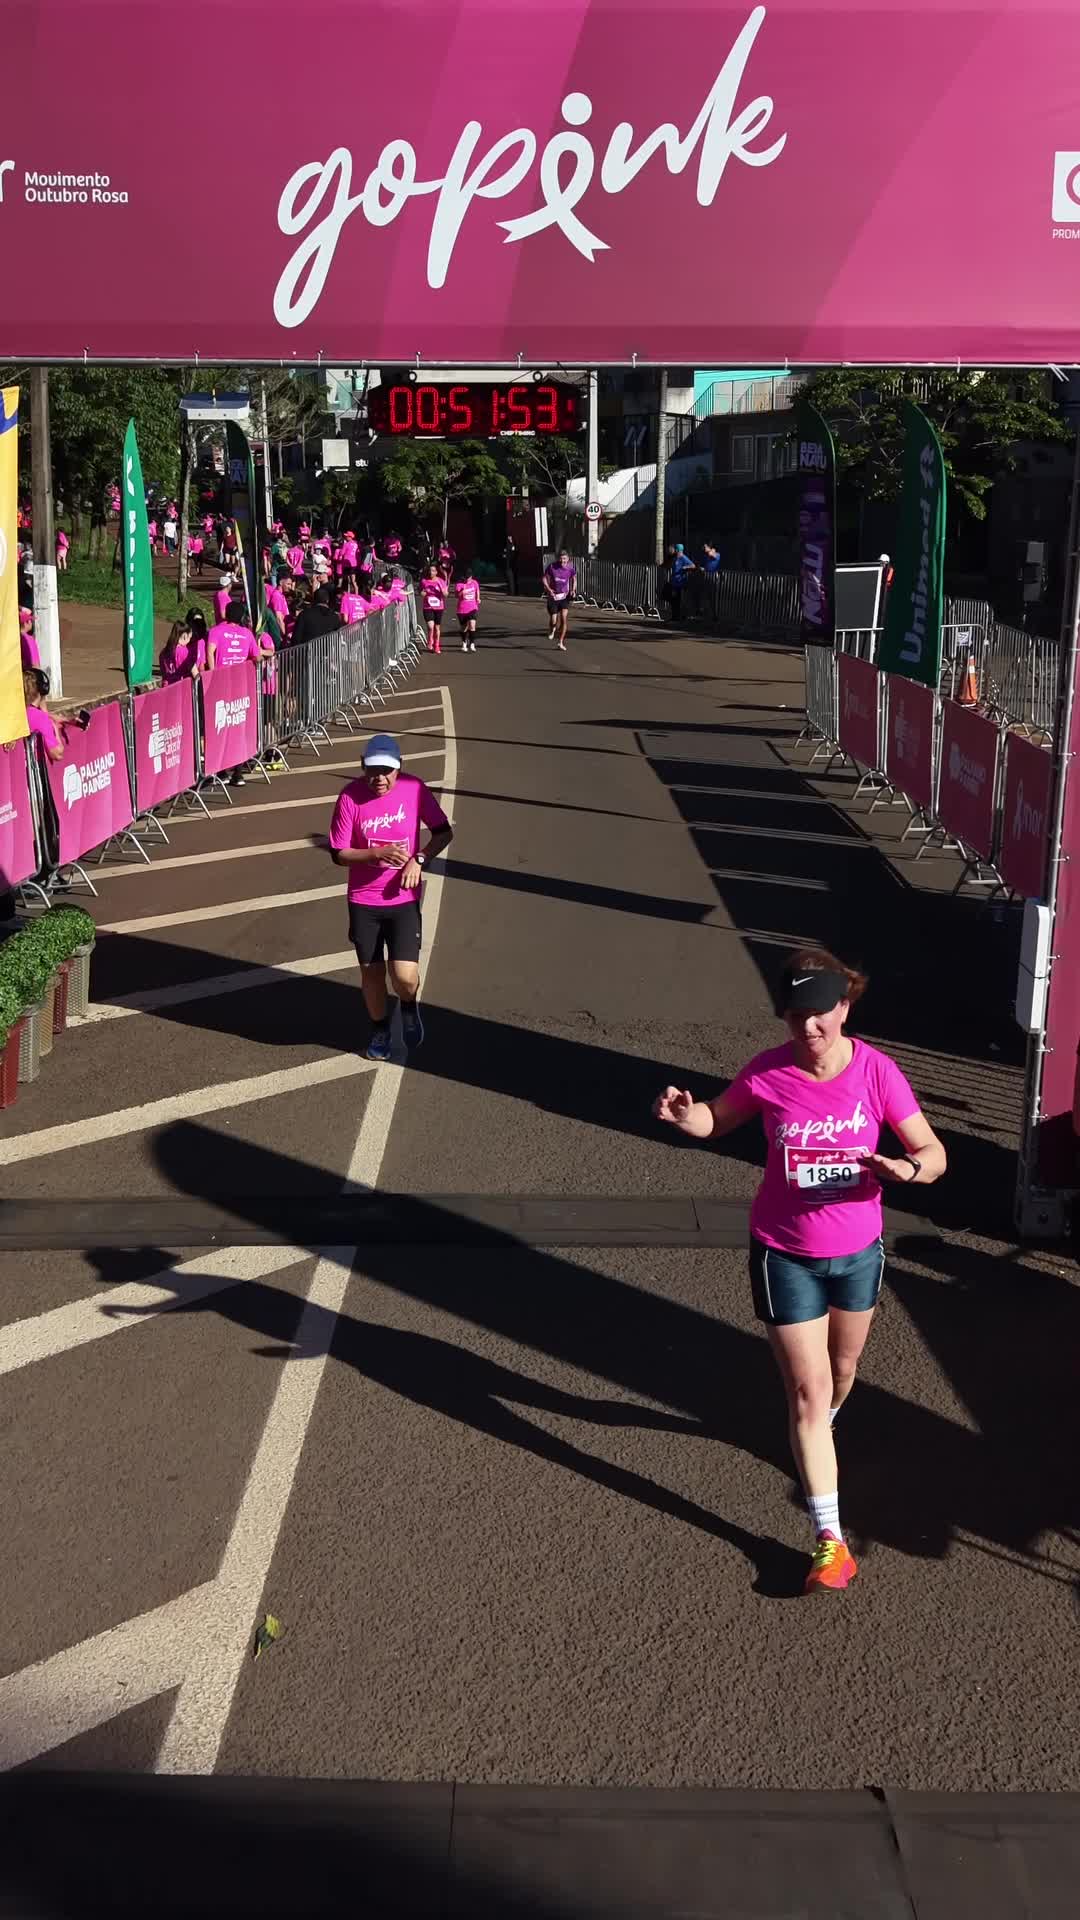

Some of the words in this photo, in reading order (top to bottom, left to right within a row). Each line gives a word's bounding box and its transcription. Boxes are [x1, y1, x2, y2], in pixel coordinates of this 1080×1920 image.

[273, 5, 787, 328] gopink
[24, 171, 110, 187] Movimento
[24, 187, 88, 203] Outubro
[92, 189, 129, 203] Rosa
[389, 387, 558, 429] 00:51:53
[588, 505, 600, 513] 40
[775, 1100, 868, 1149] gopink
[806, 1166, 852, 1183] 1850
